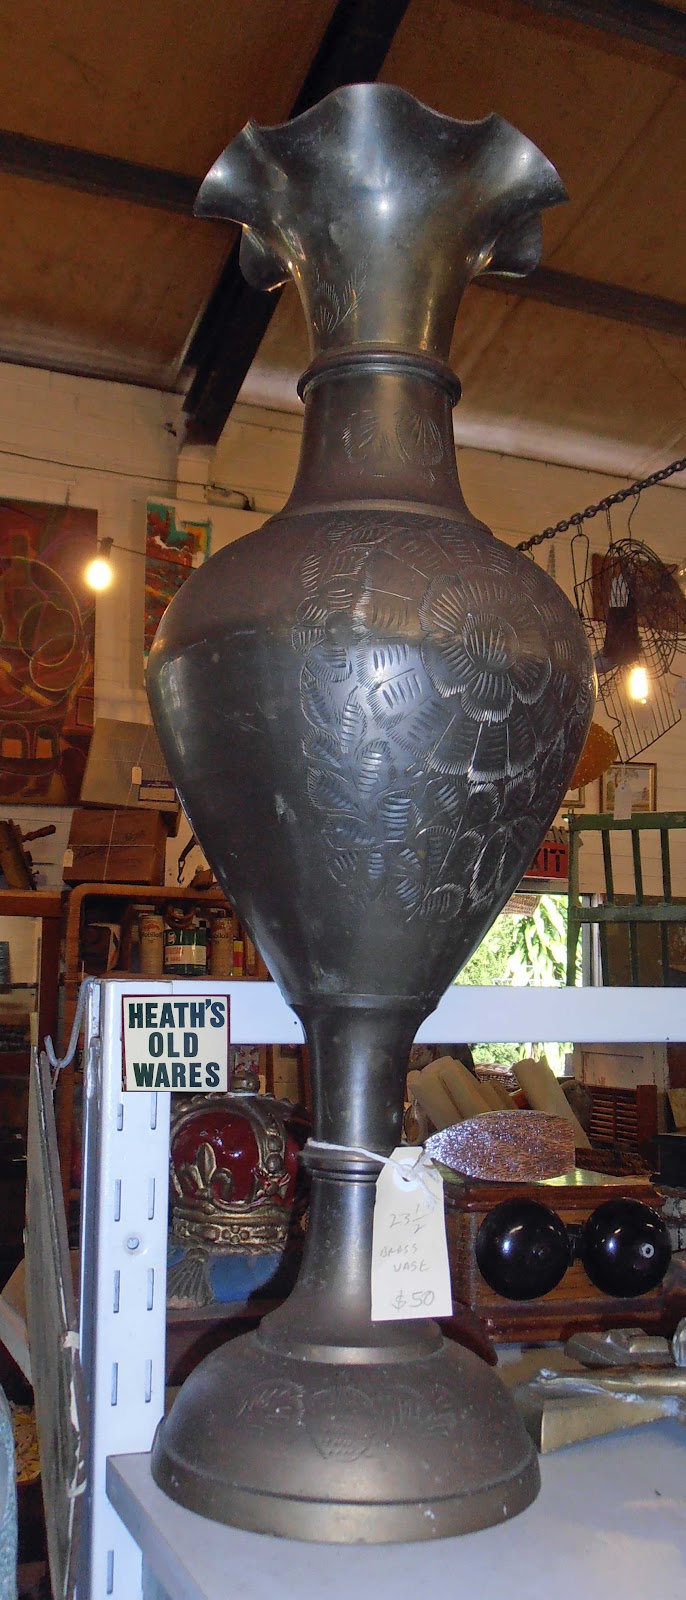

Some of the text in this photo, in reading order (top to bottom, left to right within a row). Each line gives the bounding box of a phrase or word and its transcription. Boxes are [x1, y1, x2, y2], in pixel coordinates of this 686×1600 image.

[529, 848, 566, 872] XIT
[128, 999, 225, 1028] HEATH'S
[148, 1032, 199, 1057] OLD
[132, 1062, 220, 1087] WARES
[379, 1243, 418, 1257] BRASS
[393, 1259, 430, 1272] VASE
